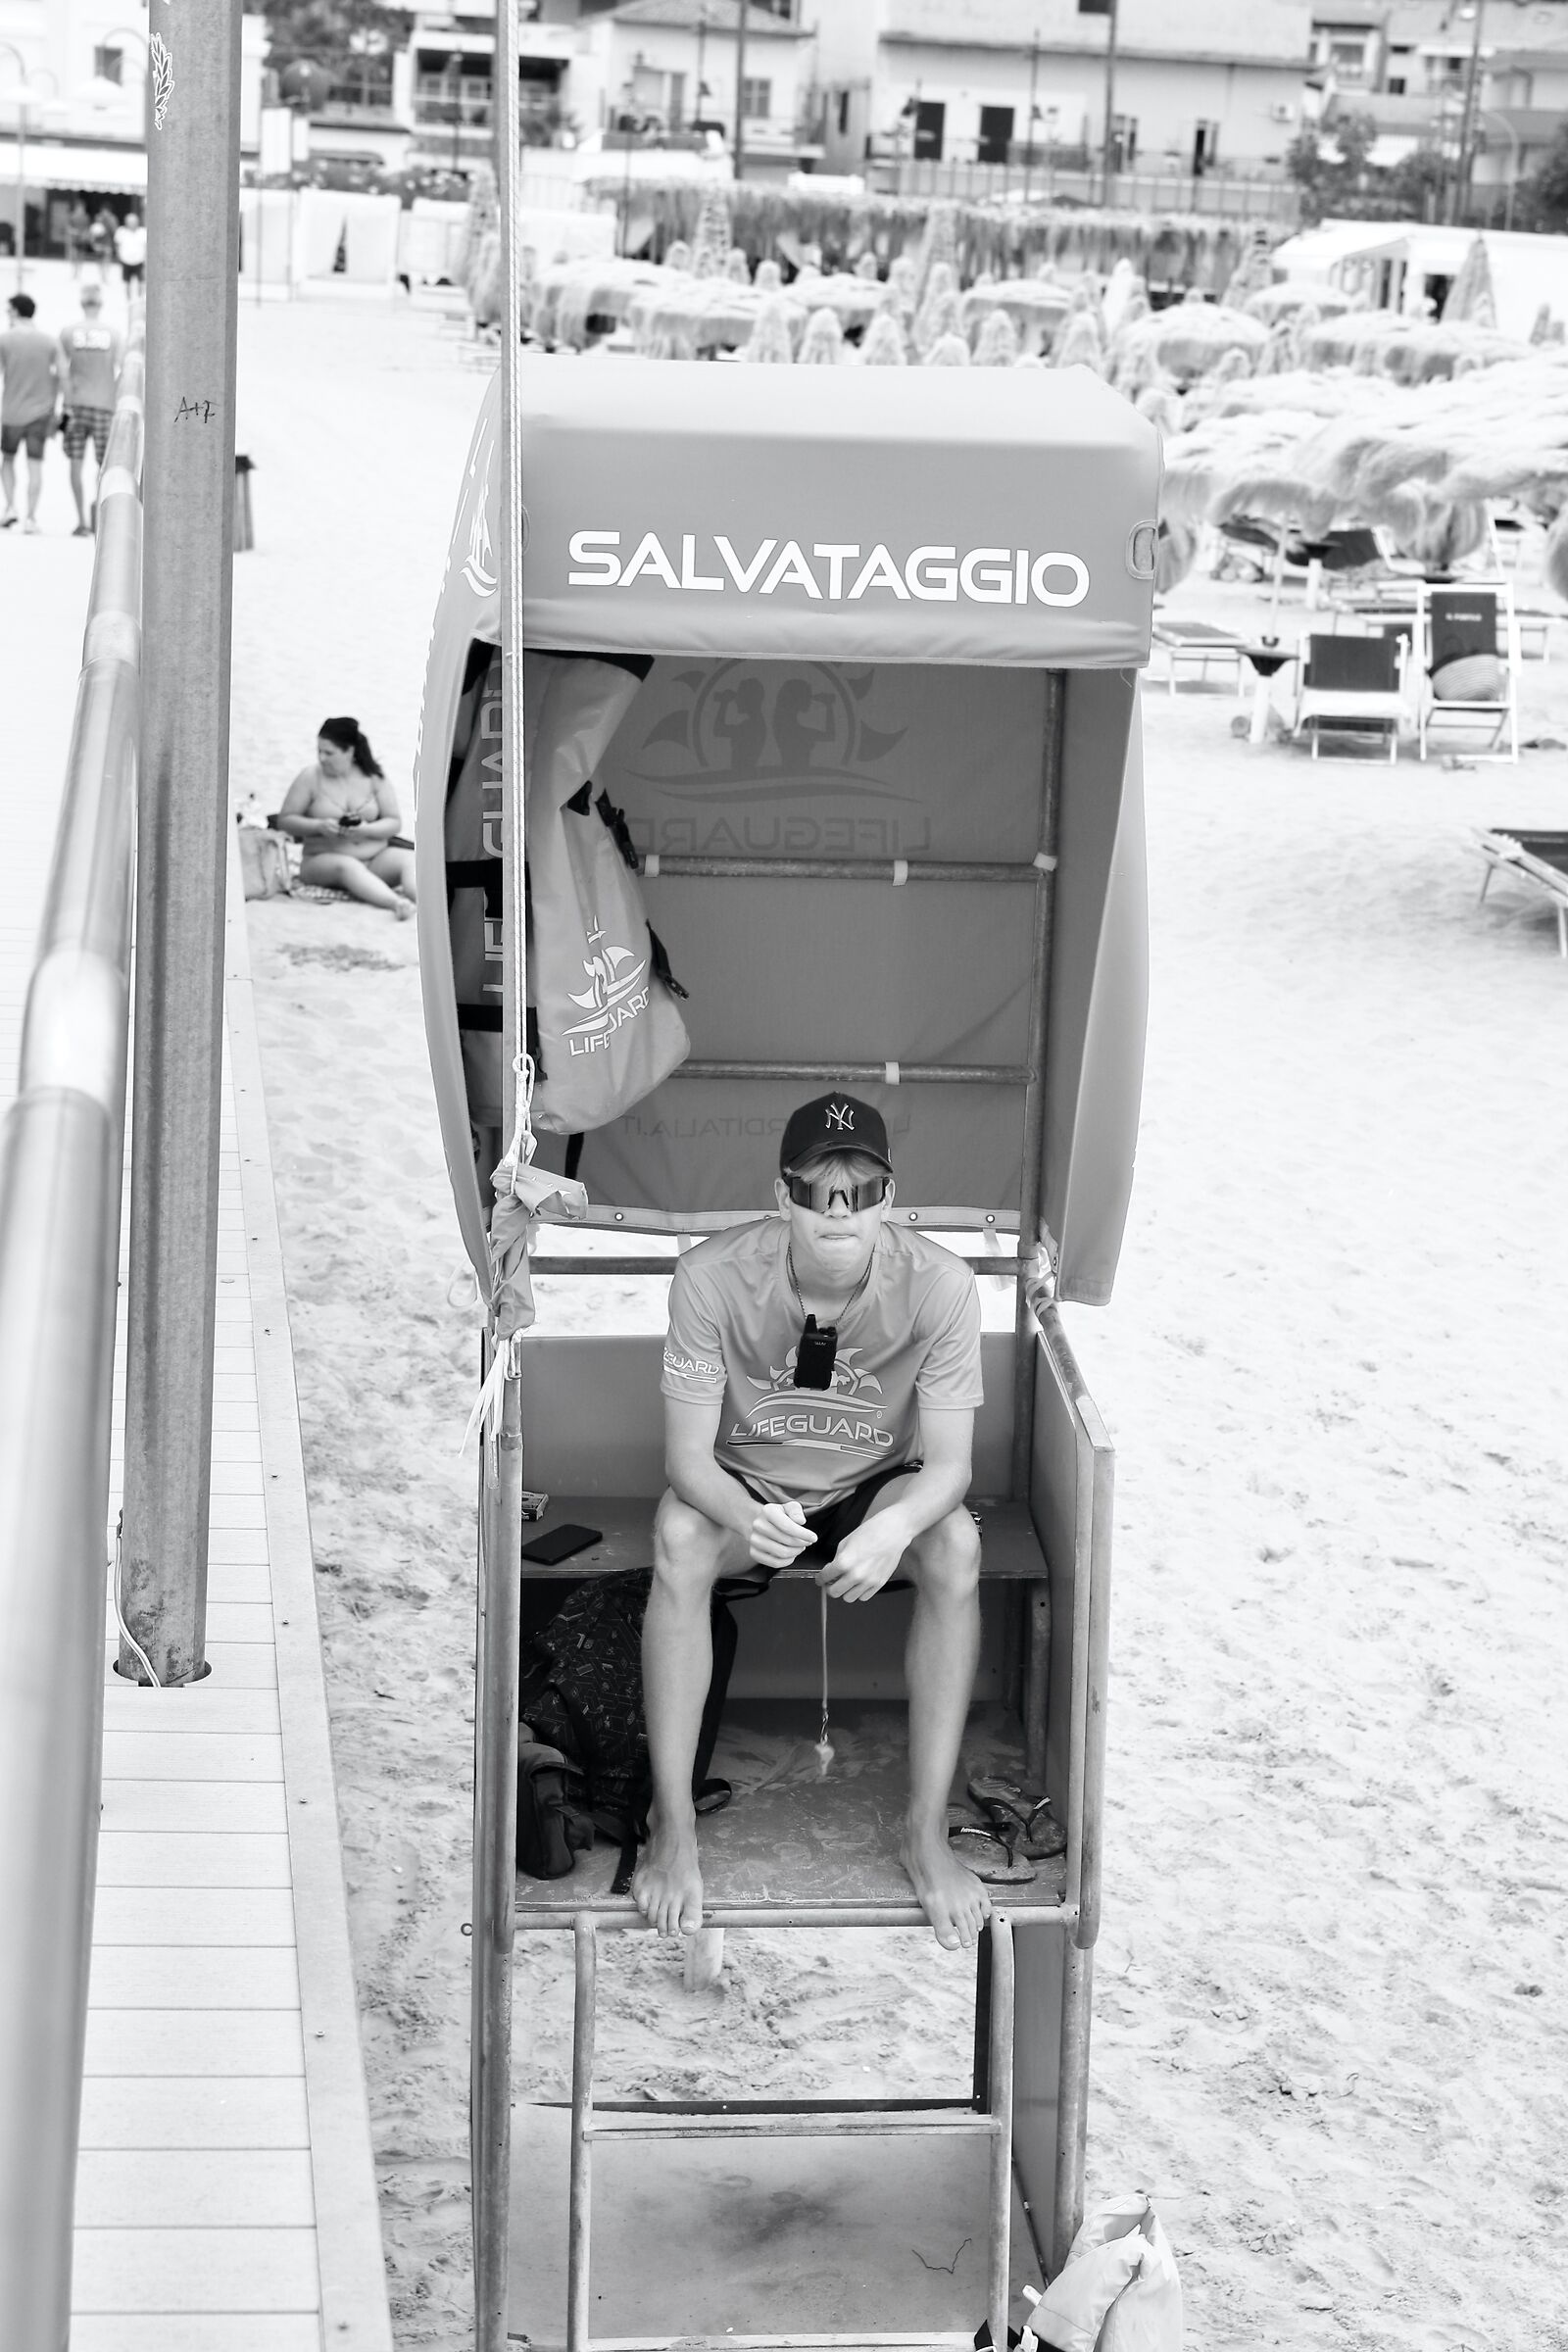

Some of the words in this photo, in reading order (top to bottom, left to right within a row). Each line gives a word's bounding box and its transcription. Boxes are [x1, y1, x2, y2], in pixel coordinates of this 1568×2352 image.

[567, 529, 1091, 608] SALVATAGGIO
[825, 1102, 855, 1131] NY
[729, 1414, 894, 1447] LIFEGUARD
